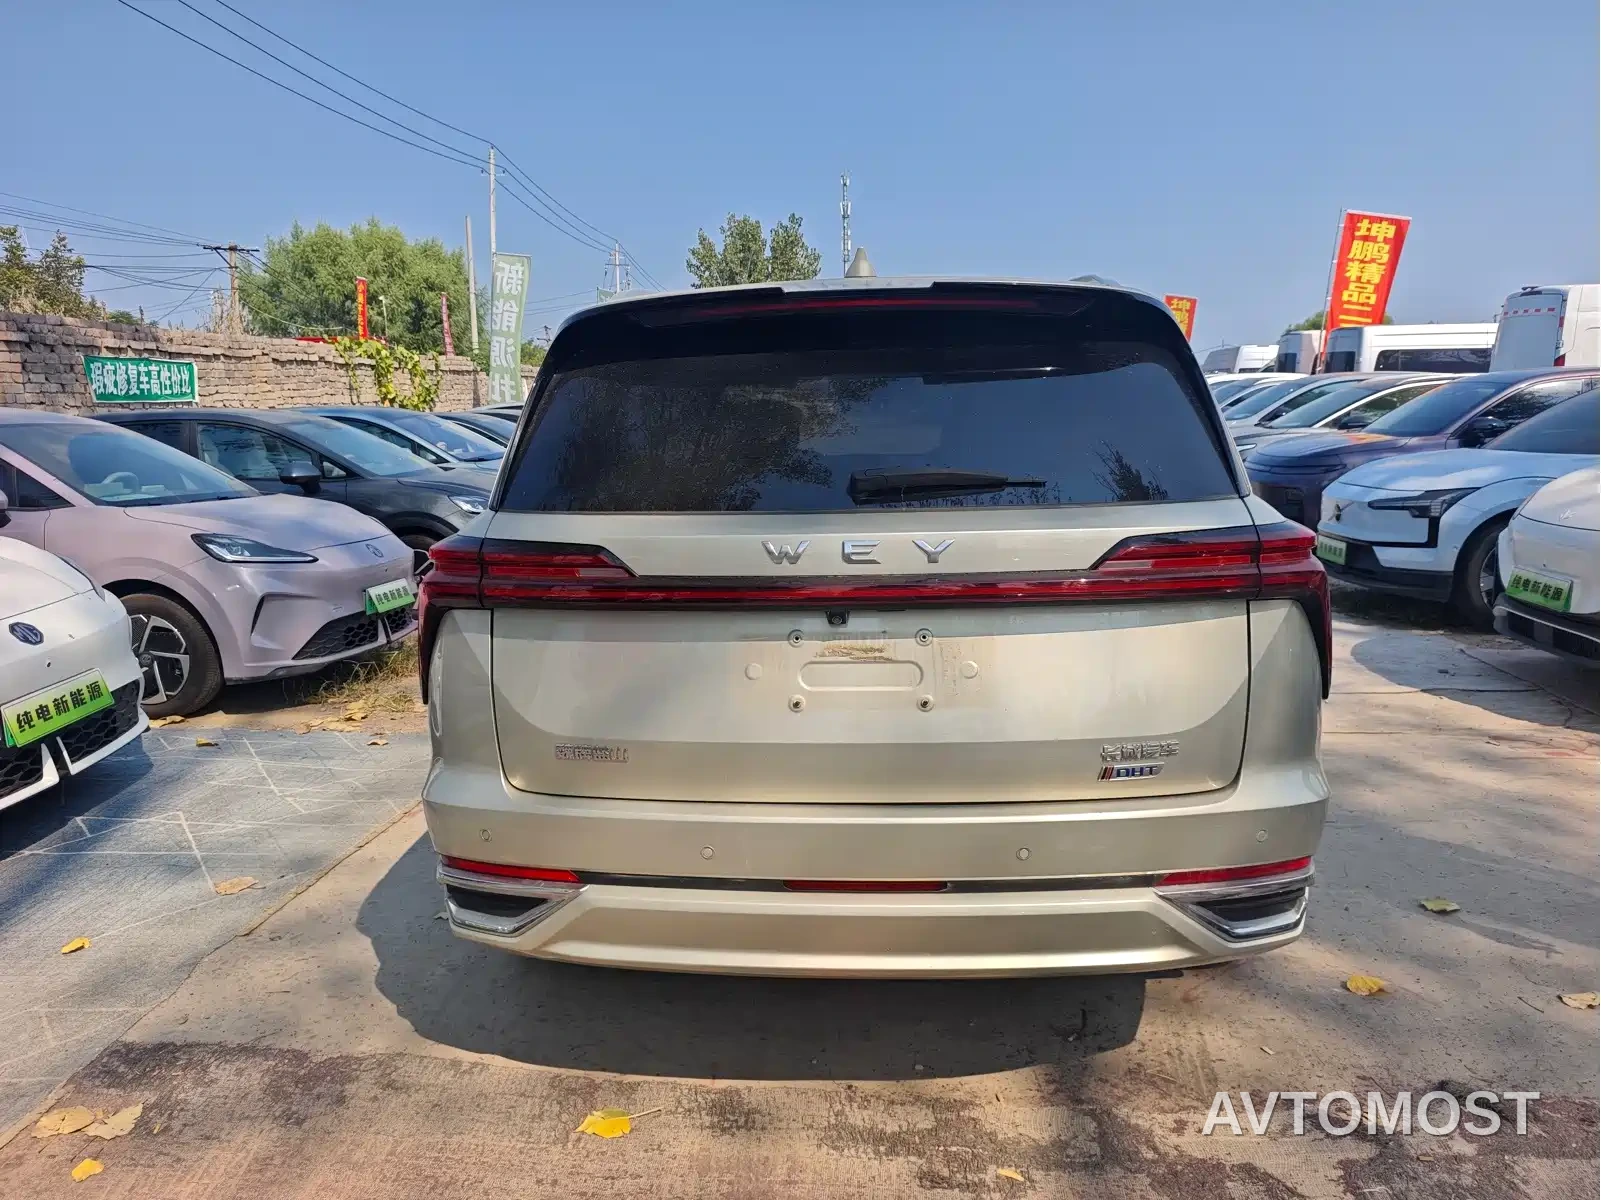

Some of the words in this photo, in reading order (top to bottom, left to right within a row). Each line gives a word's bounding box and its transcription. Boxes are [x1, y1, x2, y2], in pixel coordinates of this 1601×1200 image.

[1339, 218, 1396, 327] 坤鹏精品二
[90, 362, 191, 396] 瑕疵修复车高性价比
[761, 538, 956, 565] WEY
[1511, 574, 1564, 601] 纯电新能源
[16, 680, 104, 734] 纯电新能源
[1115, 765, 1158, 778] DHT
